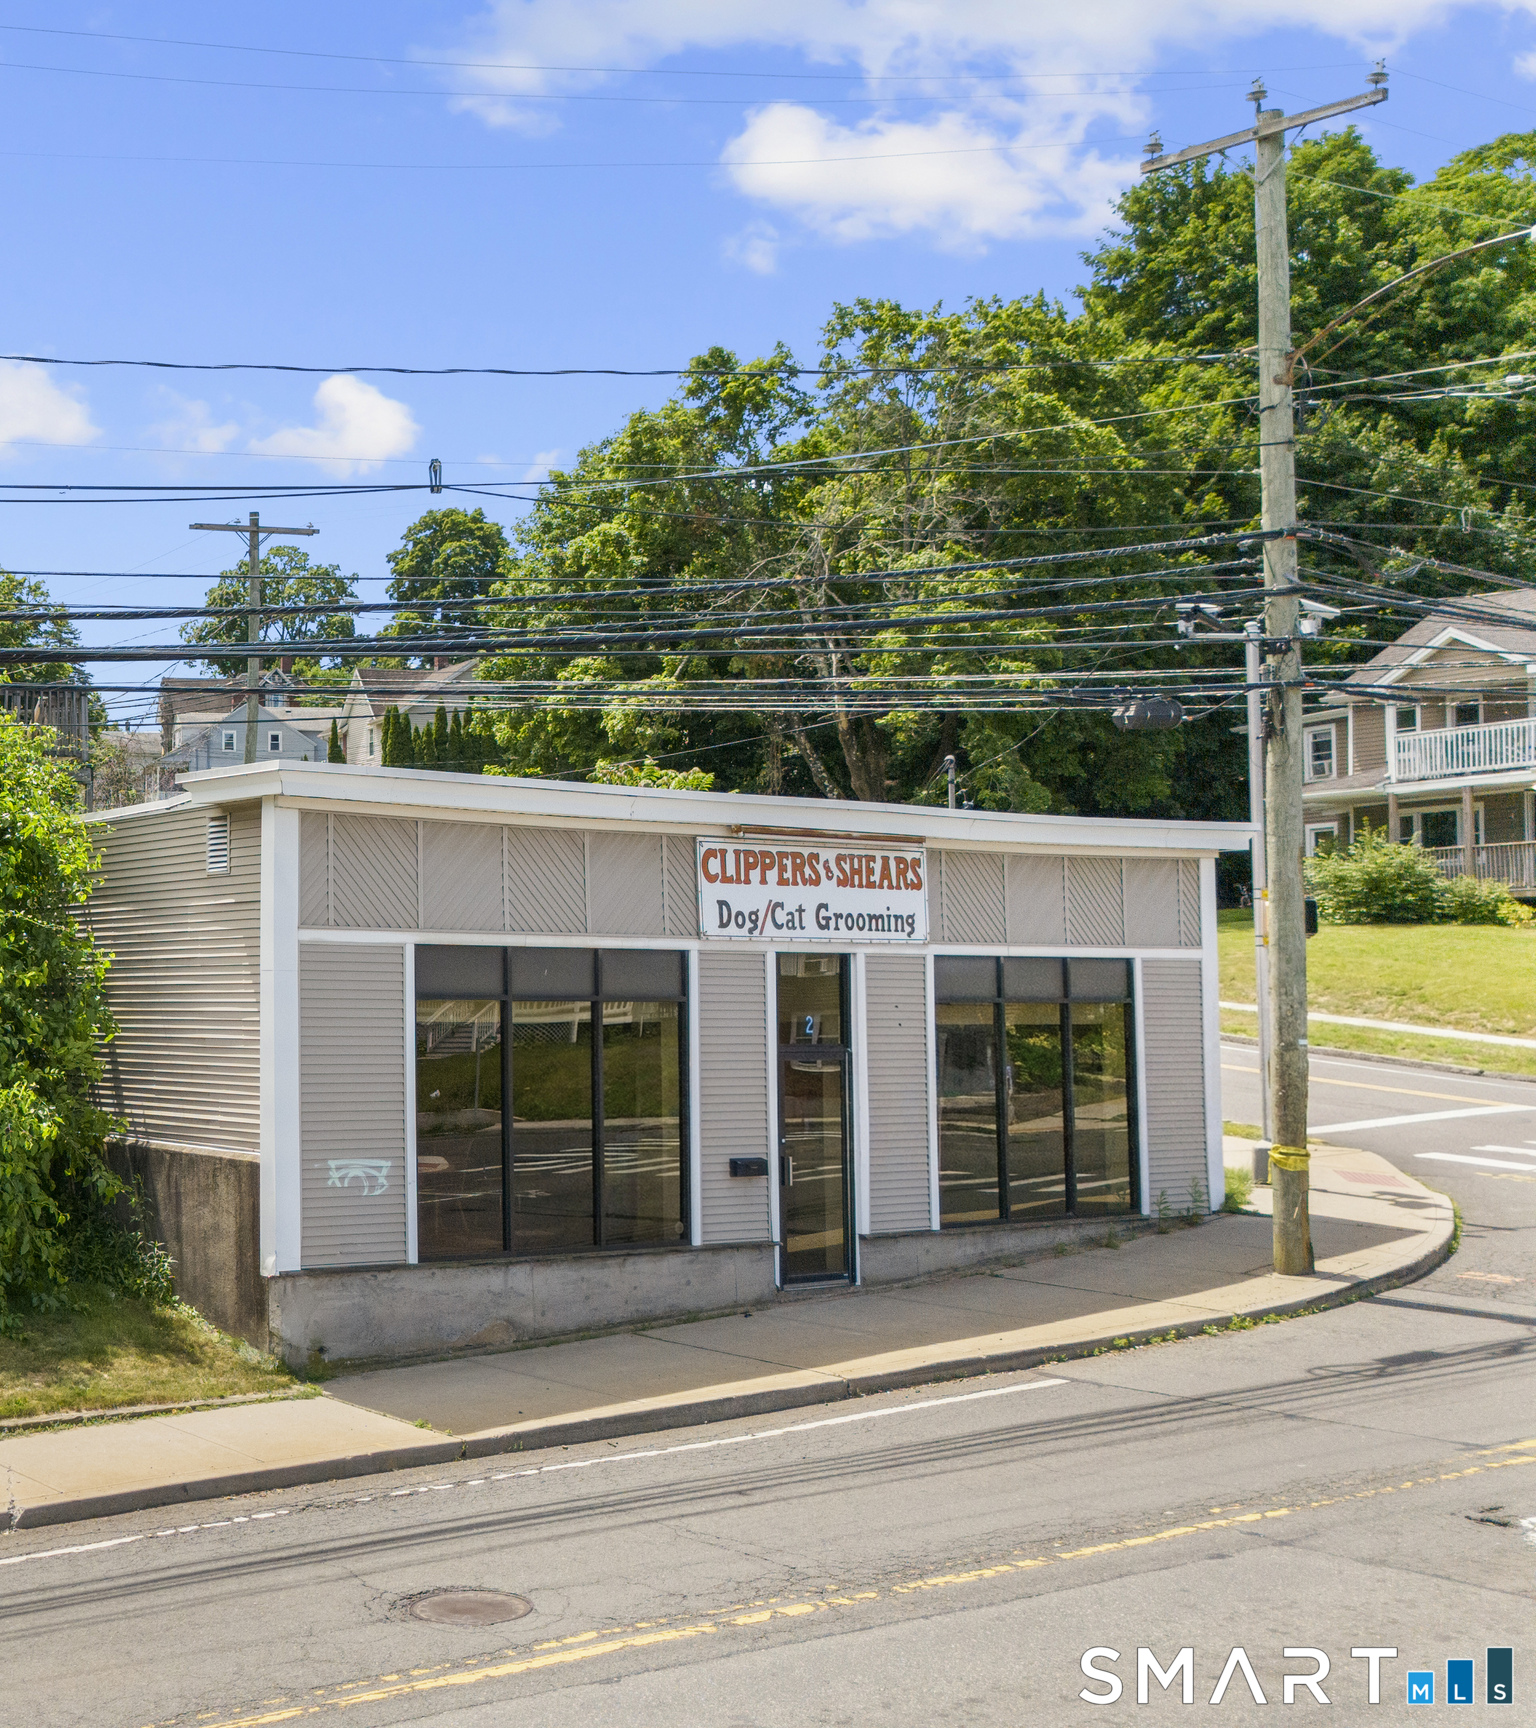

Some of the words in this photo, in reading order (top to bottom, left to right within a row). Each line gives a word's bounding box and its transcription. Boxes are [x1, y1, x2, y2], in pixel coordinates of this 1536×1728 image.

[701, 848, 821, 887] CLIPPERS
[835, 853, 923, 891] SHEARS
[716, 899, 806, 935] Dog/Cat
[815, 903, 916, 938] Grooming
[805, 1015, 813, 1034] 2
